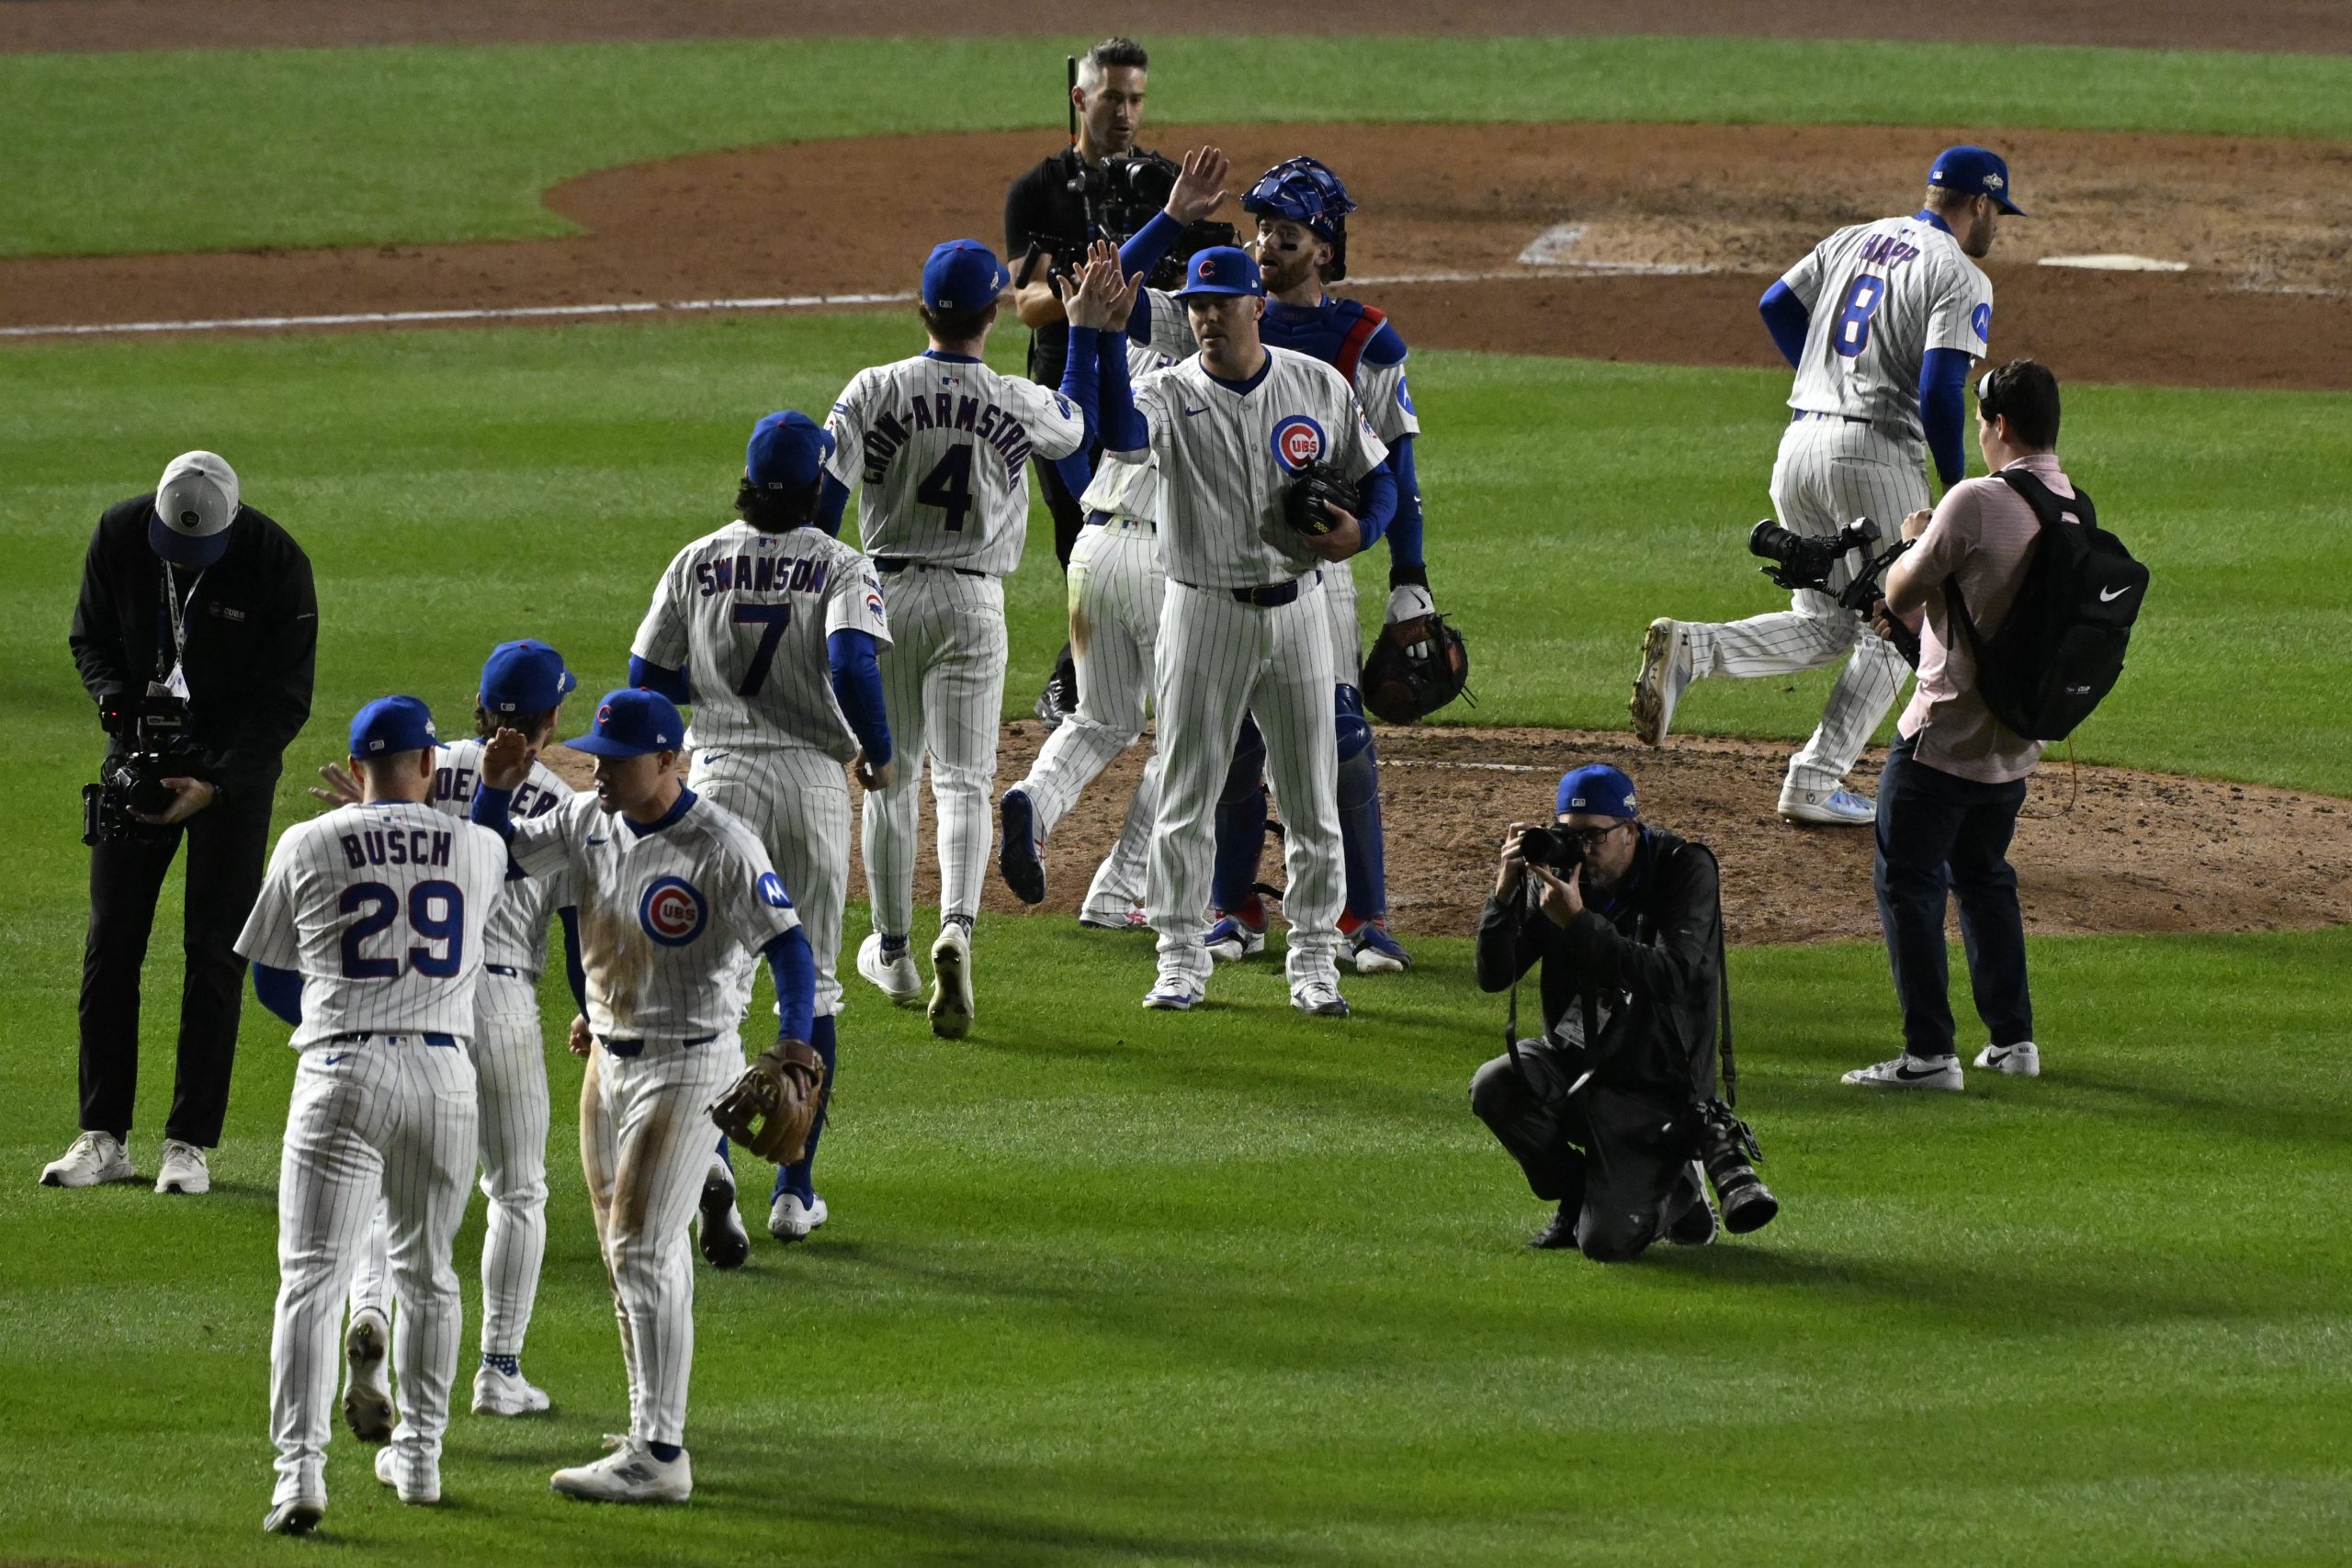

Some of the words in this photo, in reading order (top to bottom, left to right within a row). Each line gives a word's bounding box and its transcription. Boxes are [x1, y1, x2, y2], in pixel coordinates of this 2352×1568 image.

[1859, 233, 1920, 270] HAPP
[1833, 274, 1884, 357] 8
[918, 443, 974, 532] 4
[695, 555, 829, 598] SWANSON
[733, 602, 792, 697] 7
[341, 829, 452, 870] BUSCH
[338, 879, 464, 979] 29
[649, 886, 696, 936] CUBS
